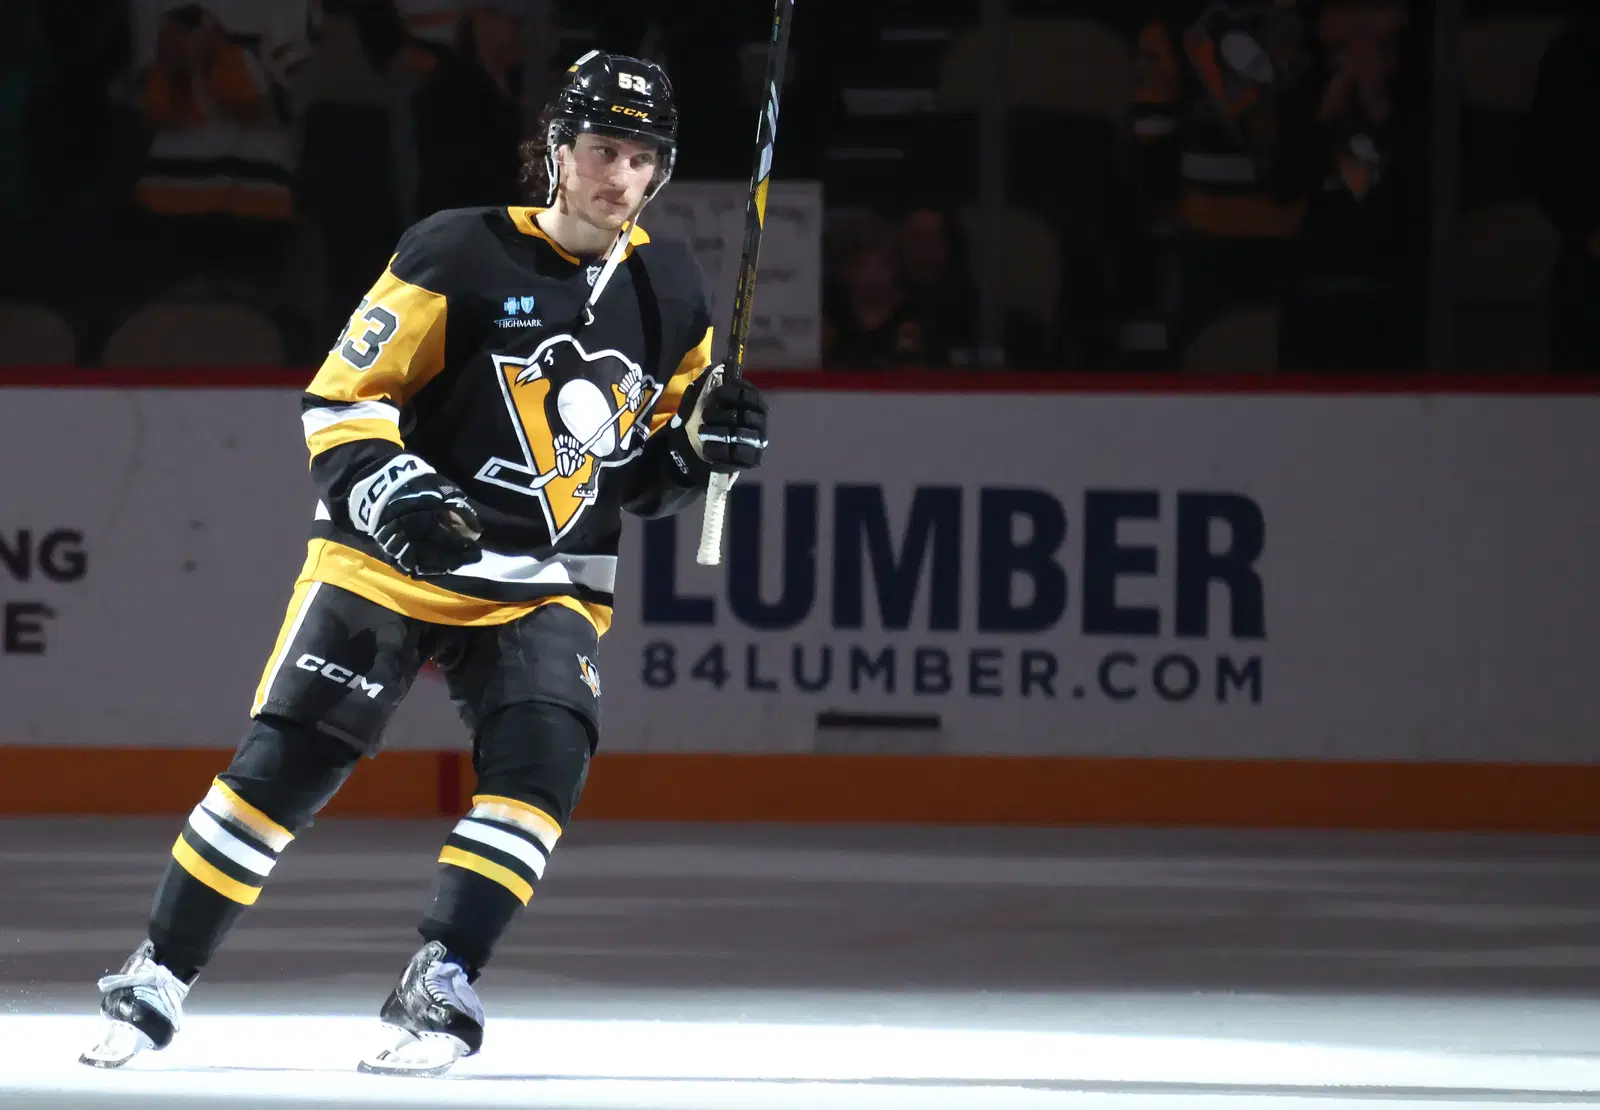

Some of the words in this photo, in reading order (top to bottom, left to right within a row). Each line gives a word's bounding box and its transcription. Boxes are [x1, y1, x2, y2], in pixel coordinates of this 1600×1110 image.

[618, 72, 647, 93] 53
[611, 105, 649, 119] CCM
[496, 318, 543, 328] HIGHMARK
[358, 459, 418, 526] CCM
[642, 483, 1267, 639] LUMBER
[295, 653, 385, 699] CCM
[642, 641, 1263, 706] 84LUMBER.COM
